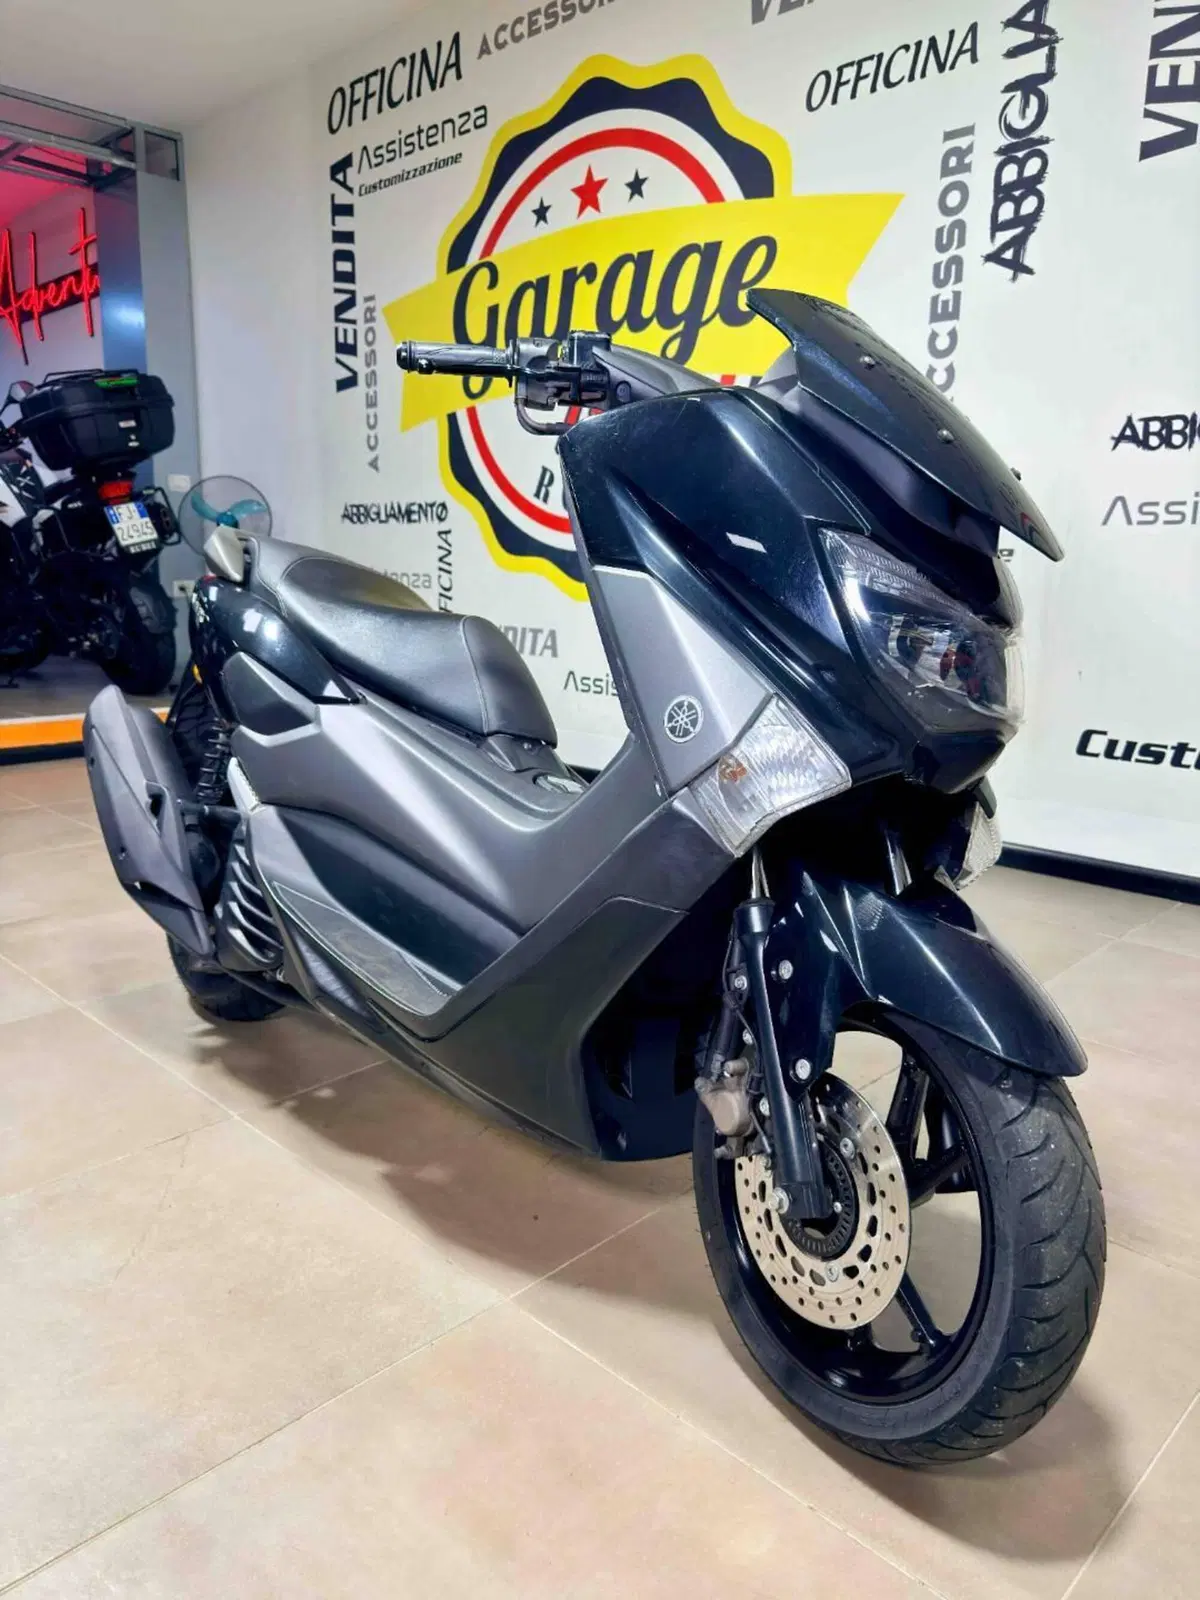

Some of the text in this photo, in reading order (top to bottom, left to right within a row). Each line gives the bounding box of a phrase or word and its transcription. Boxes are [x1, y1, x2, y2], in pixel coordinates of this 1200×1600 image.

[328, 31, 463, 135] OFFICINA
[805, 21, 979, 113] OFFICINA
[357, 104, 488, 174] Assistenza
[358, 152, 463, 197] Customizzazione
[330, 152, 358, 393] VENDITA
[925, 122, 976, 402] CCESSORI
[452, 234, 778, 400] Garage
[363, 294, 381, 473] ACCESSORI
[1101, 491, 1200, 526] Assi
